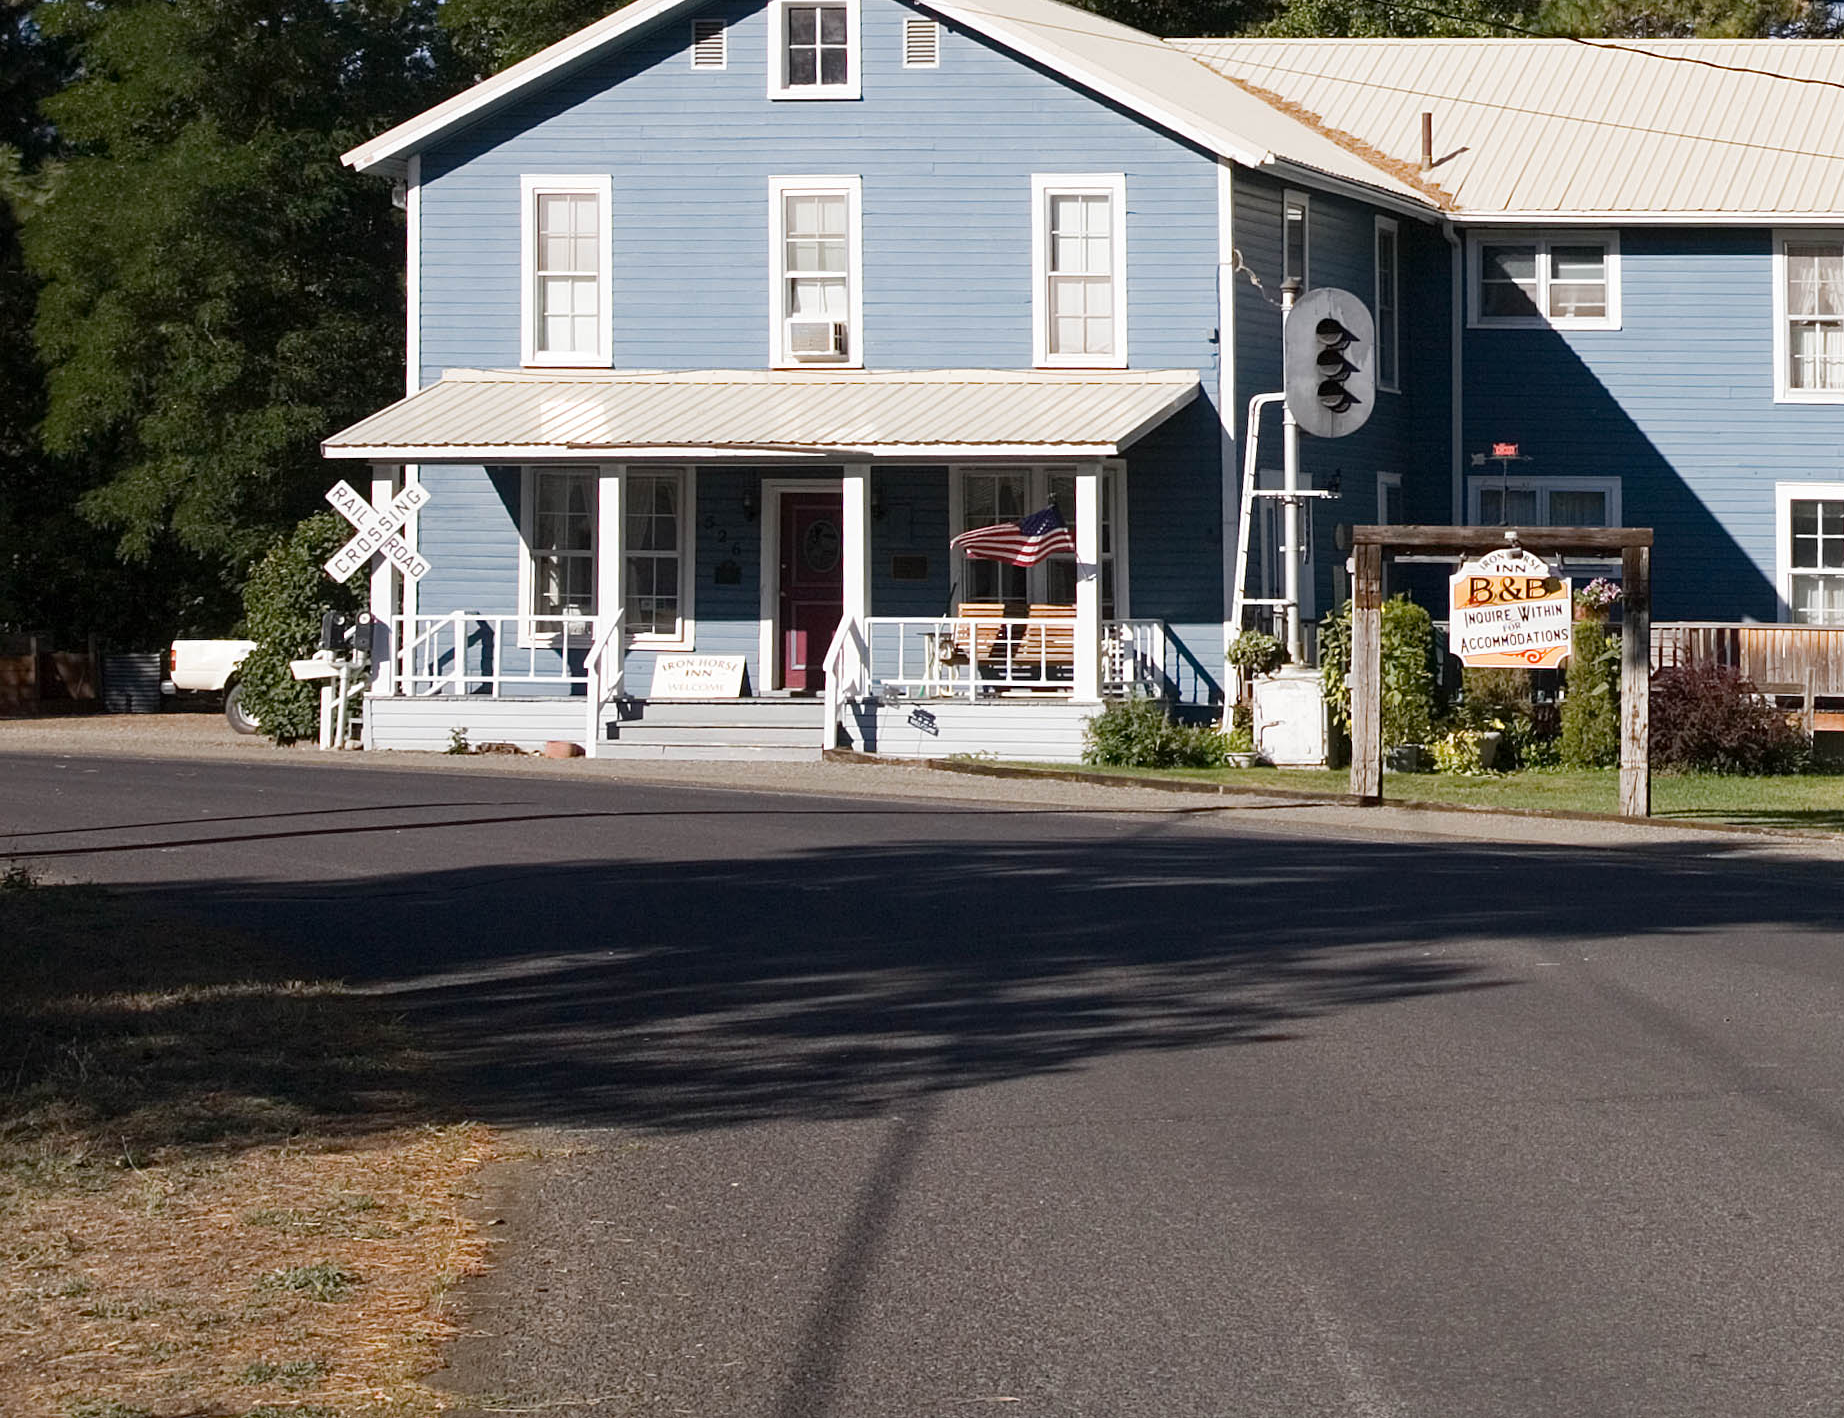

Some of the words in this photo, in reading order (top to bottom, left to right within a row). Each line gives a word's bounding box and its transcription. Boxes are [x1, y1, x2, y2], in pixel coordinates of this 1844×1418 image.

[332, 486, 368, 525] RAIL
[384, 537, 426, 578] ROAD
[334, 489, 422, 574] CROSSING
[1479, 552, 1505, 570] IRON
[1495, 565, 1526, 573] INN
[1469, 576, 1551, 603] B&B
[1464, 608, 1512, 628] INQUIRE
[1517, 604, 1563, 622] WITHIN
[1502, 622, 1521, 632] FOR
[1460, 628, 1569, 654] ACCOMMODATIONS
[662, 659, 694, 671] IRON
[699, 658, 738, 671] HORSE
[685, 669, 712, 677] INN
